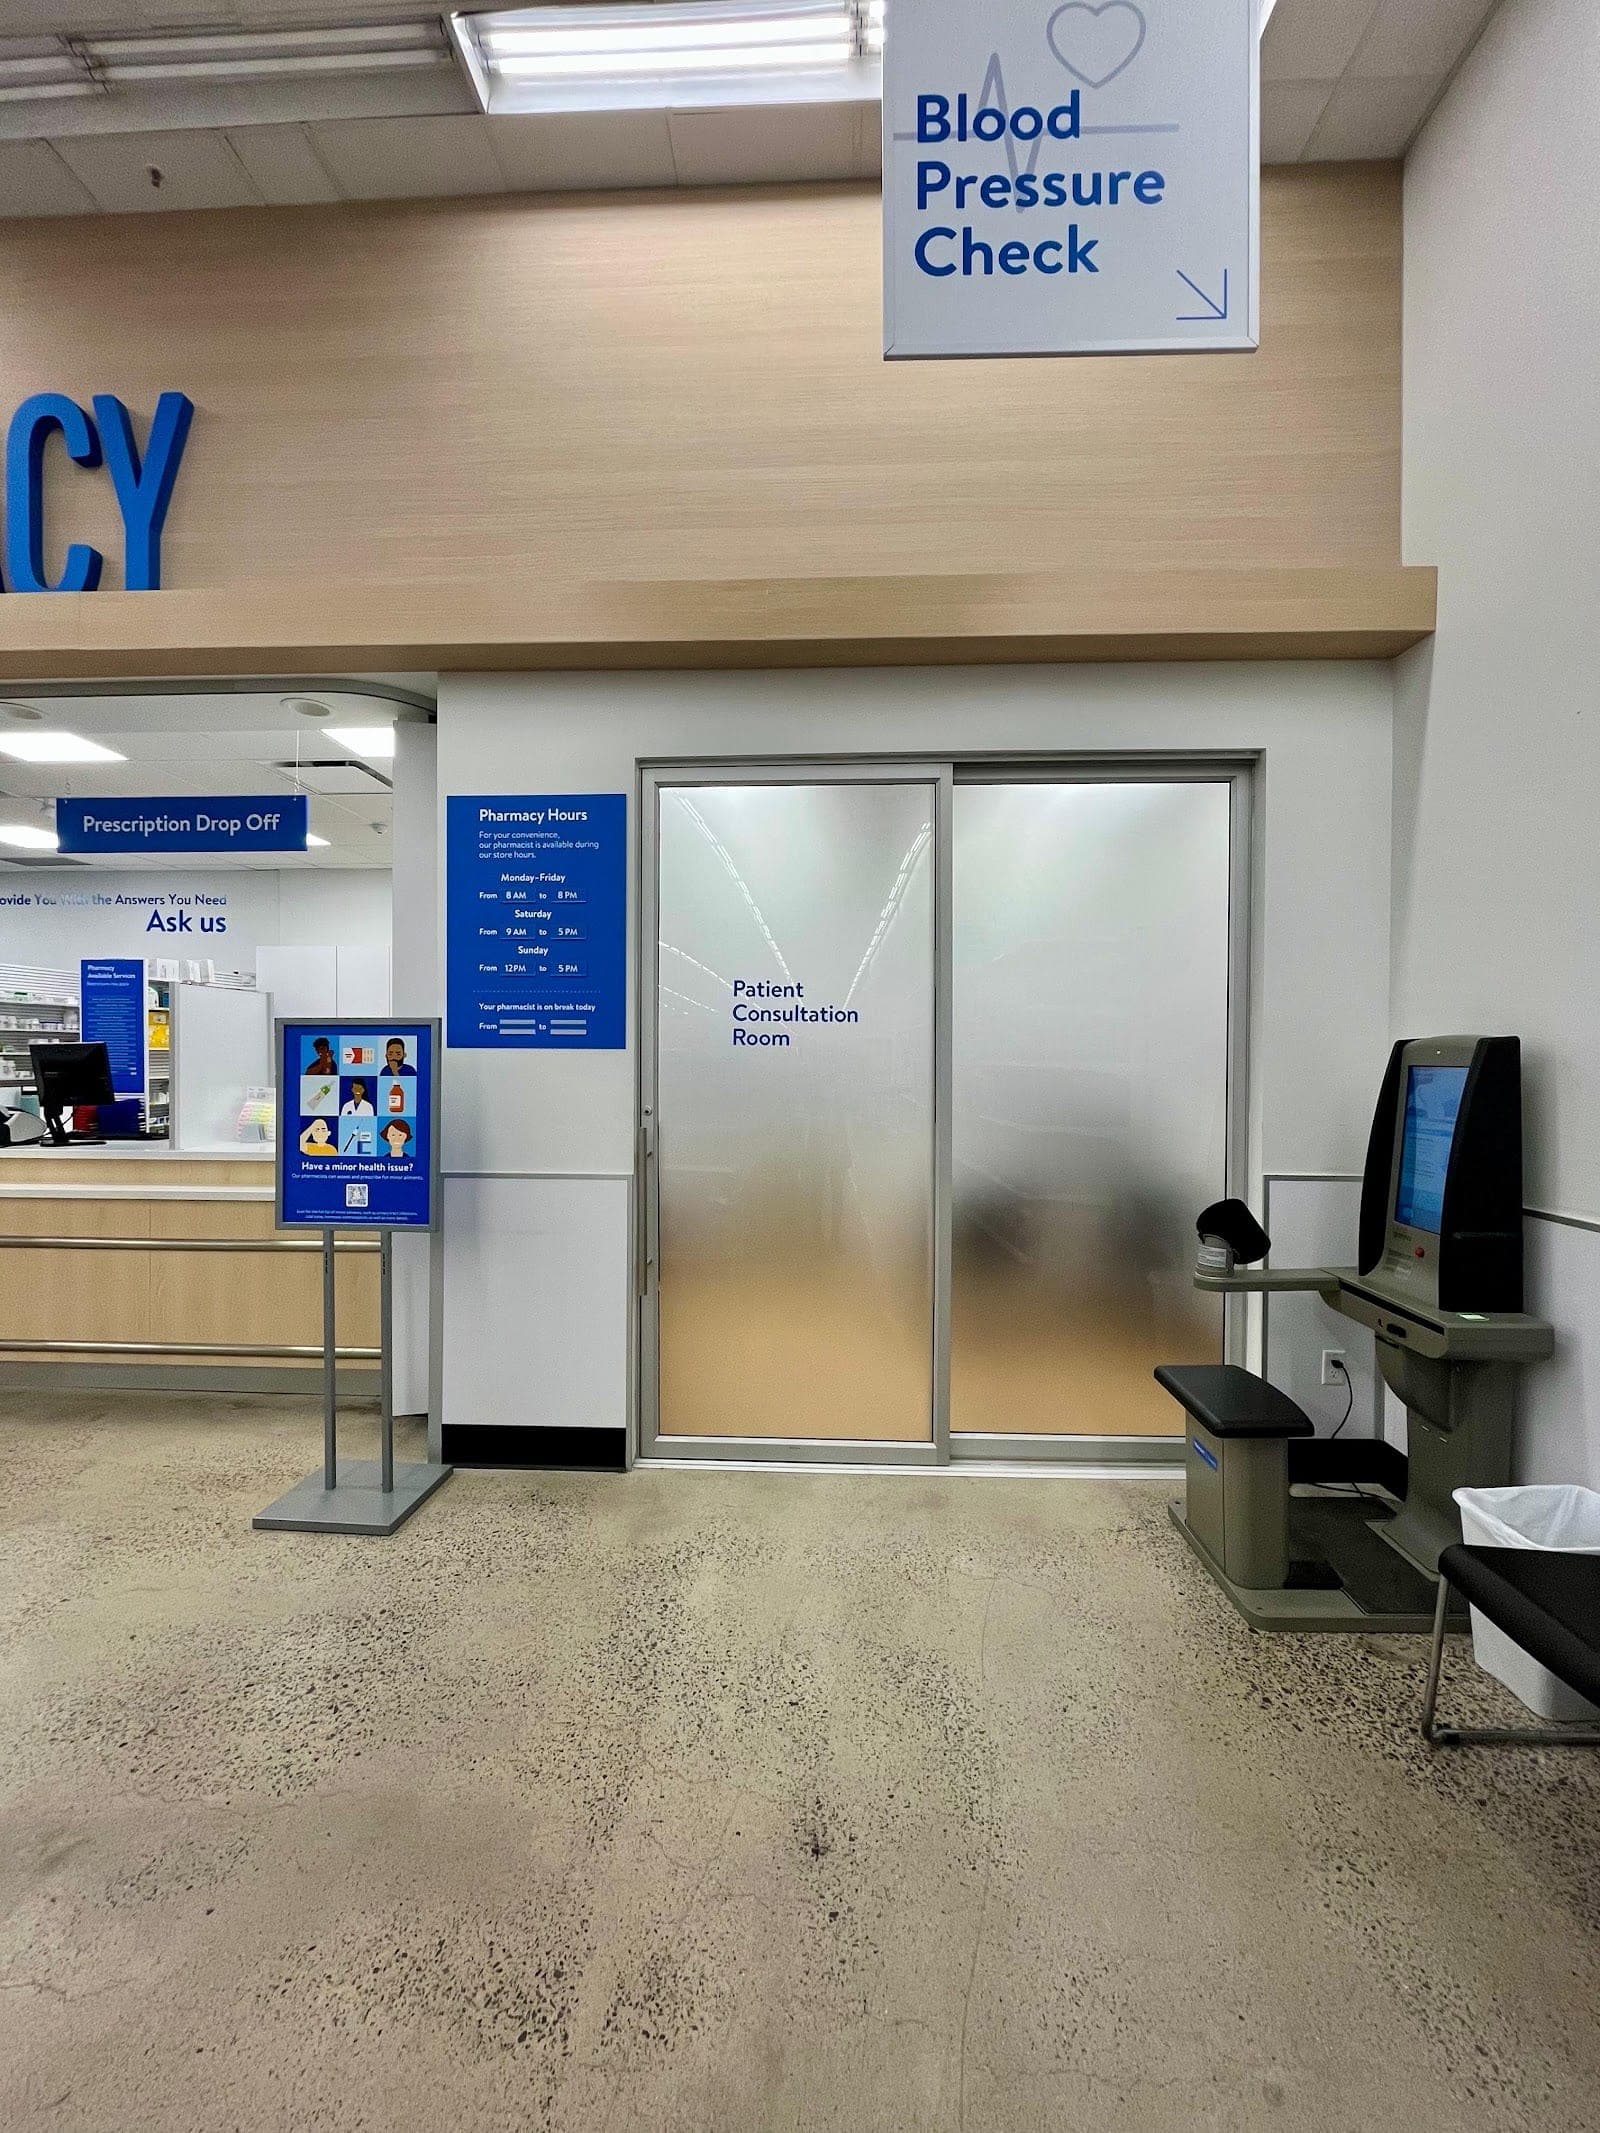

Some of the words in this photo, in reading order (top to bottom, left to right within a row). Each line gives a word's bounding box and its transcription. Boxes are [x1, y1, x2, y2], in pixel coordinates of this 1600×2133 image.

[916, 89, 1081, 143] Blood
[916, 161, 1166, 210] Pressure
[914, 224, 1100, 277] Check
[0, 391, 195, 592] CY
[479, 808, 545, 825] Pharmacy
[548, 808, 588, 821] Hours
[83, 815, 191, 837] Prescription
[196, 814, 241, 836] Drop
[246, 813, 281, 831] Off
[479, 831, 492, 839] For
[493, 832, 511, 840] your
[511, 831, 561, 840] convenience,
[493, 841, 534, 850] pharmacist
[535, 841, 541, 849] is
[542, 841, 574, 849] available
[575, 841, 600, 850] during
[493, 851, 513, 859] store
[513, 851, 537, 859] hours.
[501, 872, 566, 884] Monday-Friday
[92, 893, 112, 905] the
[115, 894, 166, 905] Answers
[168, 894, 191, 905] You
[194, 894, 227, 905] Need
[479, 891, 498, 900] From
[506, 891, 512, 900] 8
[513, 891, 527, 900] AM
[539, 892, 547, 900] to
[557, 891, 564, 900] 8
[565, 891, 578, 900] PM
[146, 909, 193, 932] Ask
[200, 916, 227, 932] us
[514, 909, 552, 920] Saturday
[479, 928, 498, 936] From
[505, 928, 511, 936] 9
[513, 928, 527, 936] AM
[539, 928, 547, 936] to
[558, 928, 564, 936] 5
[565, 928, 578, 936] PM
[518, 946, 549, 957] Sunday
[479, 964, 498, 972] From
[558, 965, 564, 973] 5
[565, 965, 578, 973] PM
[733, 979, 804, 998] Patient
[478, 1003, 496, 1011] Your
[497, 1003, 536, 1013] pharmacist
[536, 1003, 543, 1011] is
[554, 1003, 575, 1011] break
[575, 1003, 596, 1013] today
[732, 1004, 859, 1022] Consultation
[479, 1022, 498, 1031] From
[733, 1028, 790, 1046] Room
[301, 1161, 324, 1170] Have
[331, 1162, 357, 1171] minor
[358, 1162, 386, 1171] health
[387, 1162, 414, 1172] issue?
